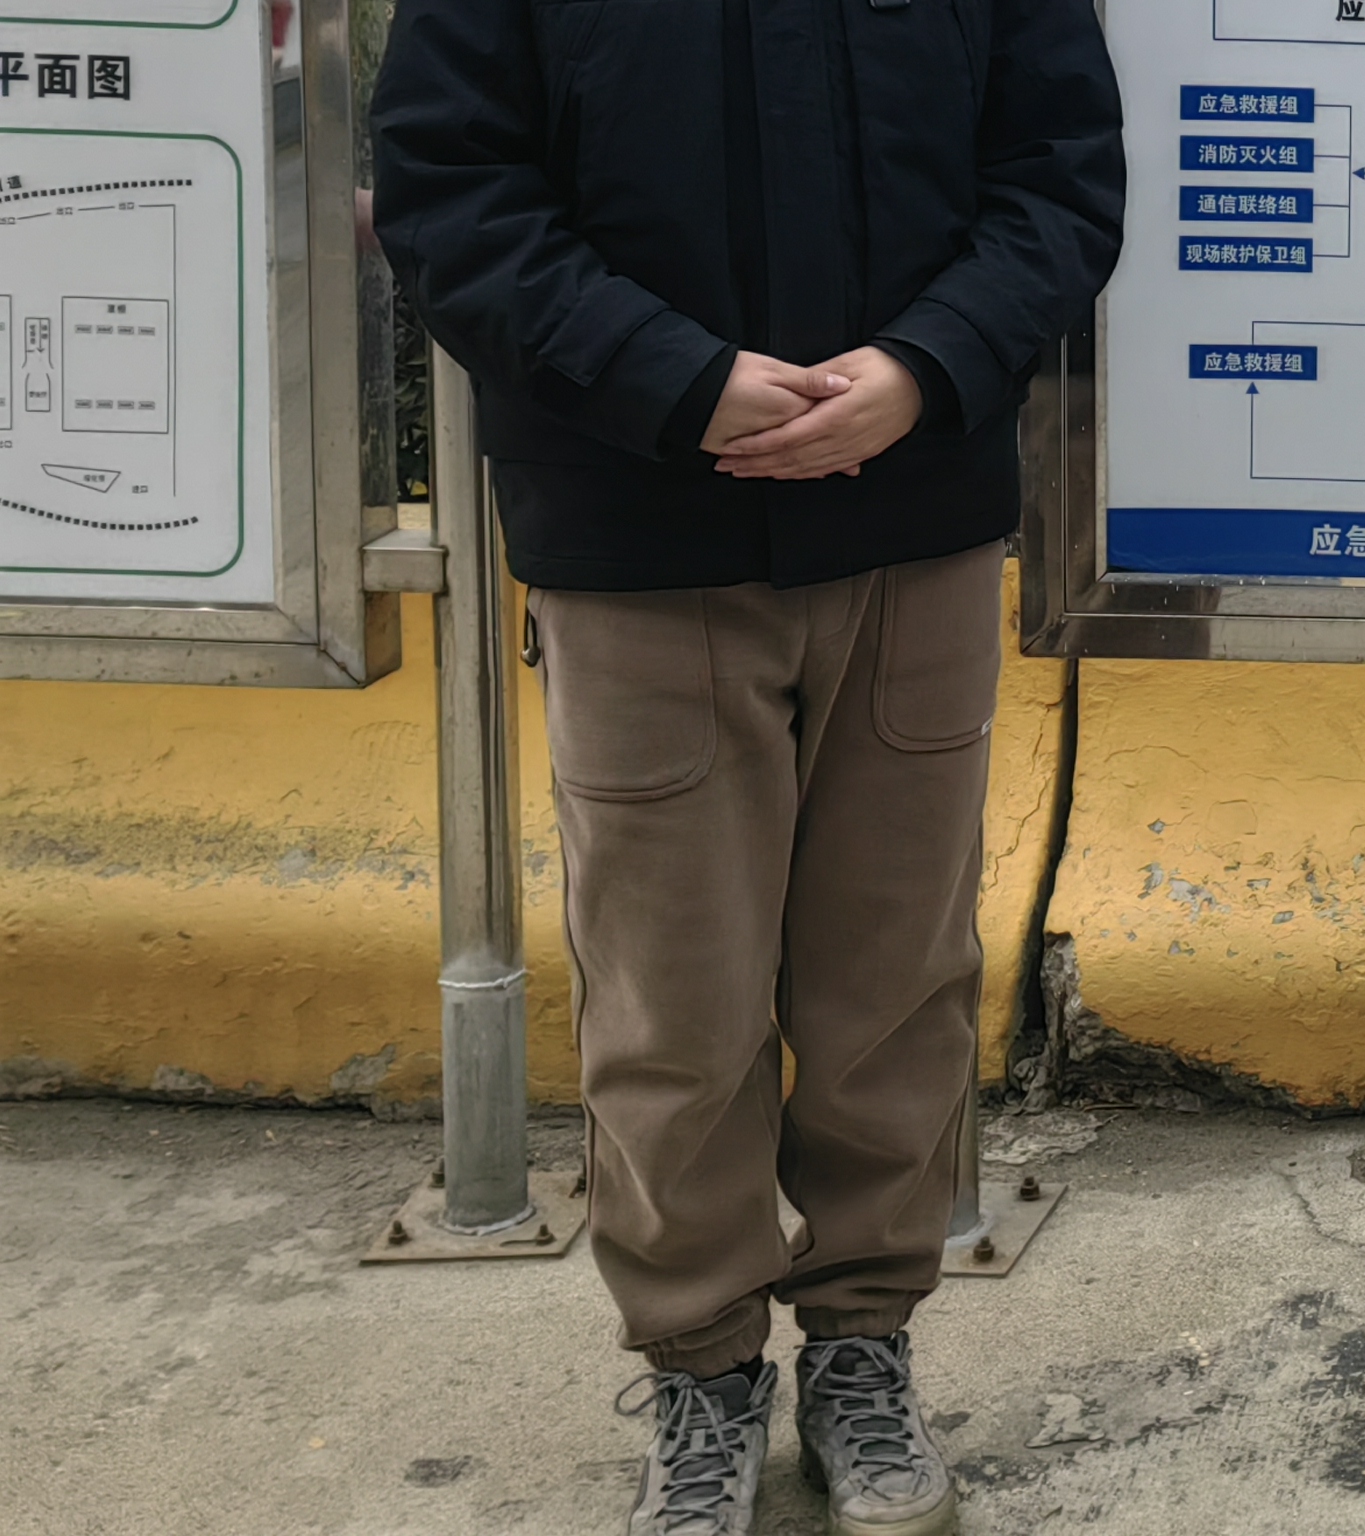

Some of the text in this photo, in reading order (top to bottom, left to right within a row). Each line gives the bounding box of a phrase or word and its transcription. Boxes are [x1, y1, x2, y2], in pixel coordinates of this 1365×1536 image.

[1198, 93, 1299, 116] 应急救援组
[1198, 143, 1299, 166] 消防灭火组
[1197, 194, 1298, 216] 通信联络组
[1204, 352, 1304, 374] 应急救援组
